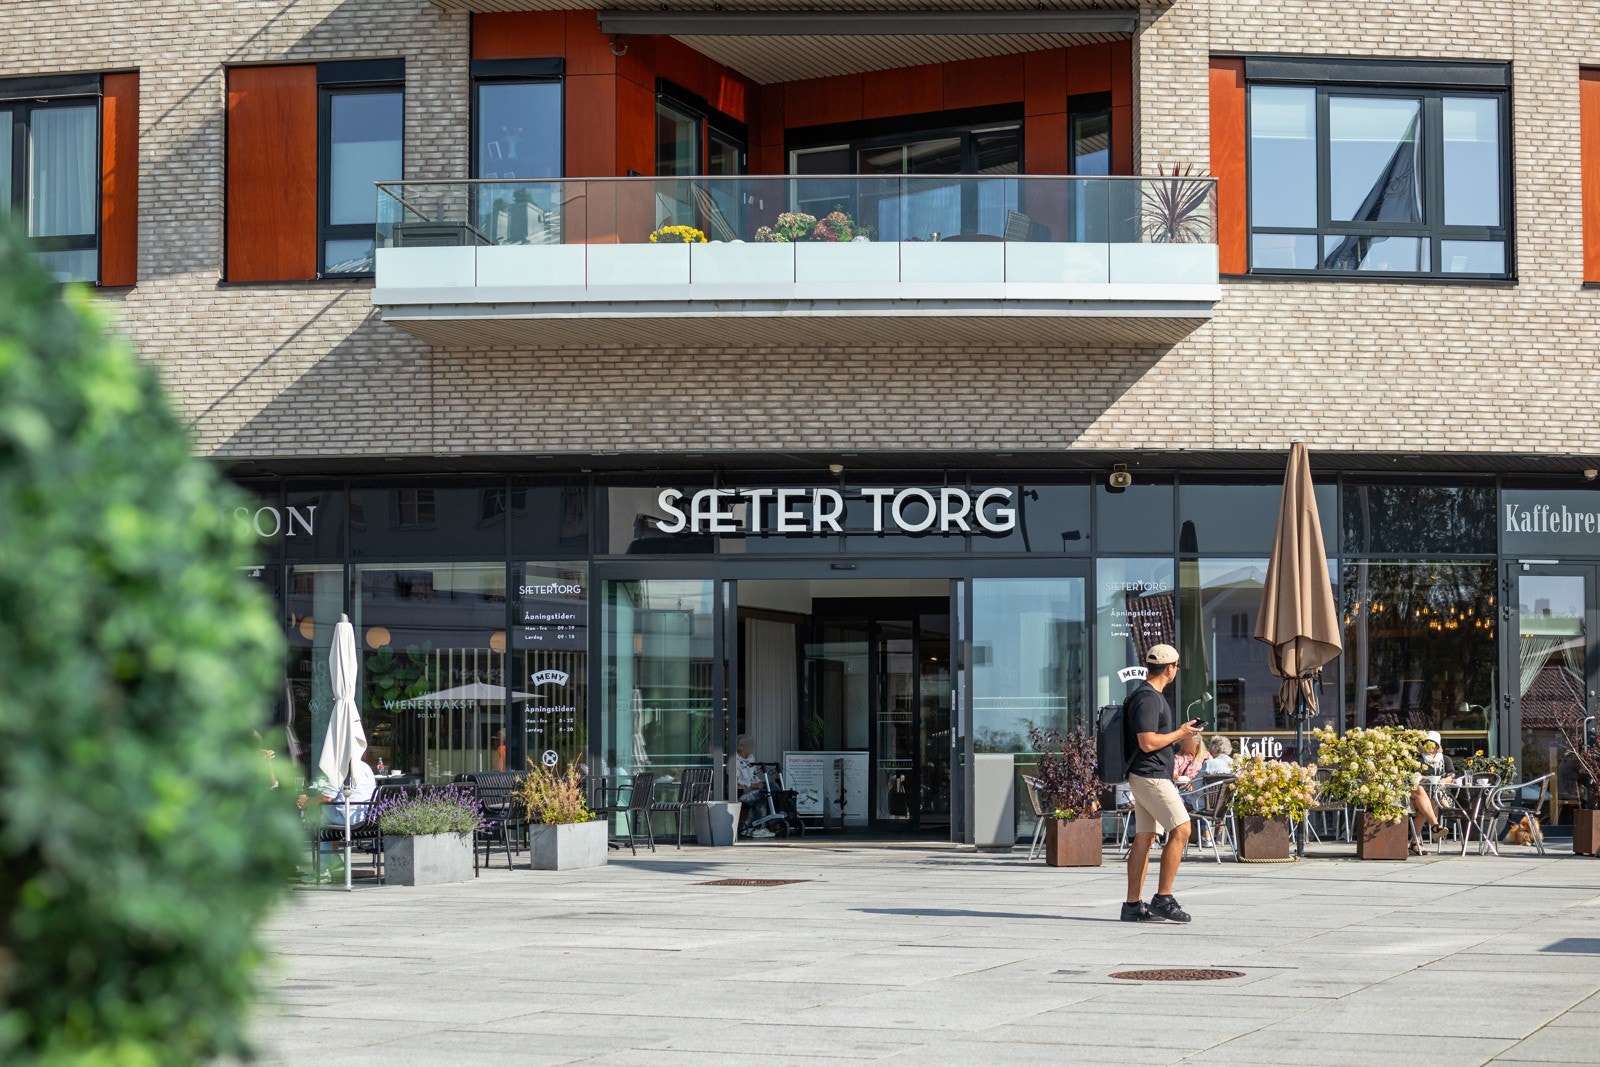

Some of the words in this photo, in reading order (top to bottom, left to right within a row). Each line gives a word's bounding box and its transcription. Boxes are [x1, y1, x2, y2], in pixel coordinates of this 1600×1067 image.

[656, 487, 844, 533] SÆTER
[861, 486, 1016, 533] TORG
[536, 672, 565, 682] MENY
[1122, 669, 1148, 678] MEN
[383, 699, 475, 710] WIENERBAKST
[524, 704, 576, 714] Åpningstider:
[1239, 736, 1283, 758] Kaffe
